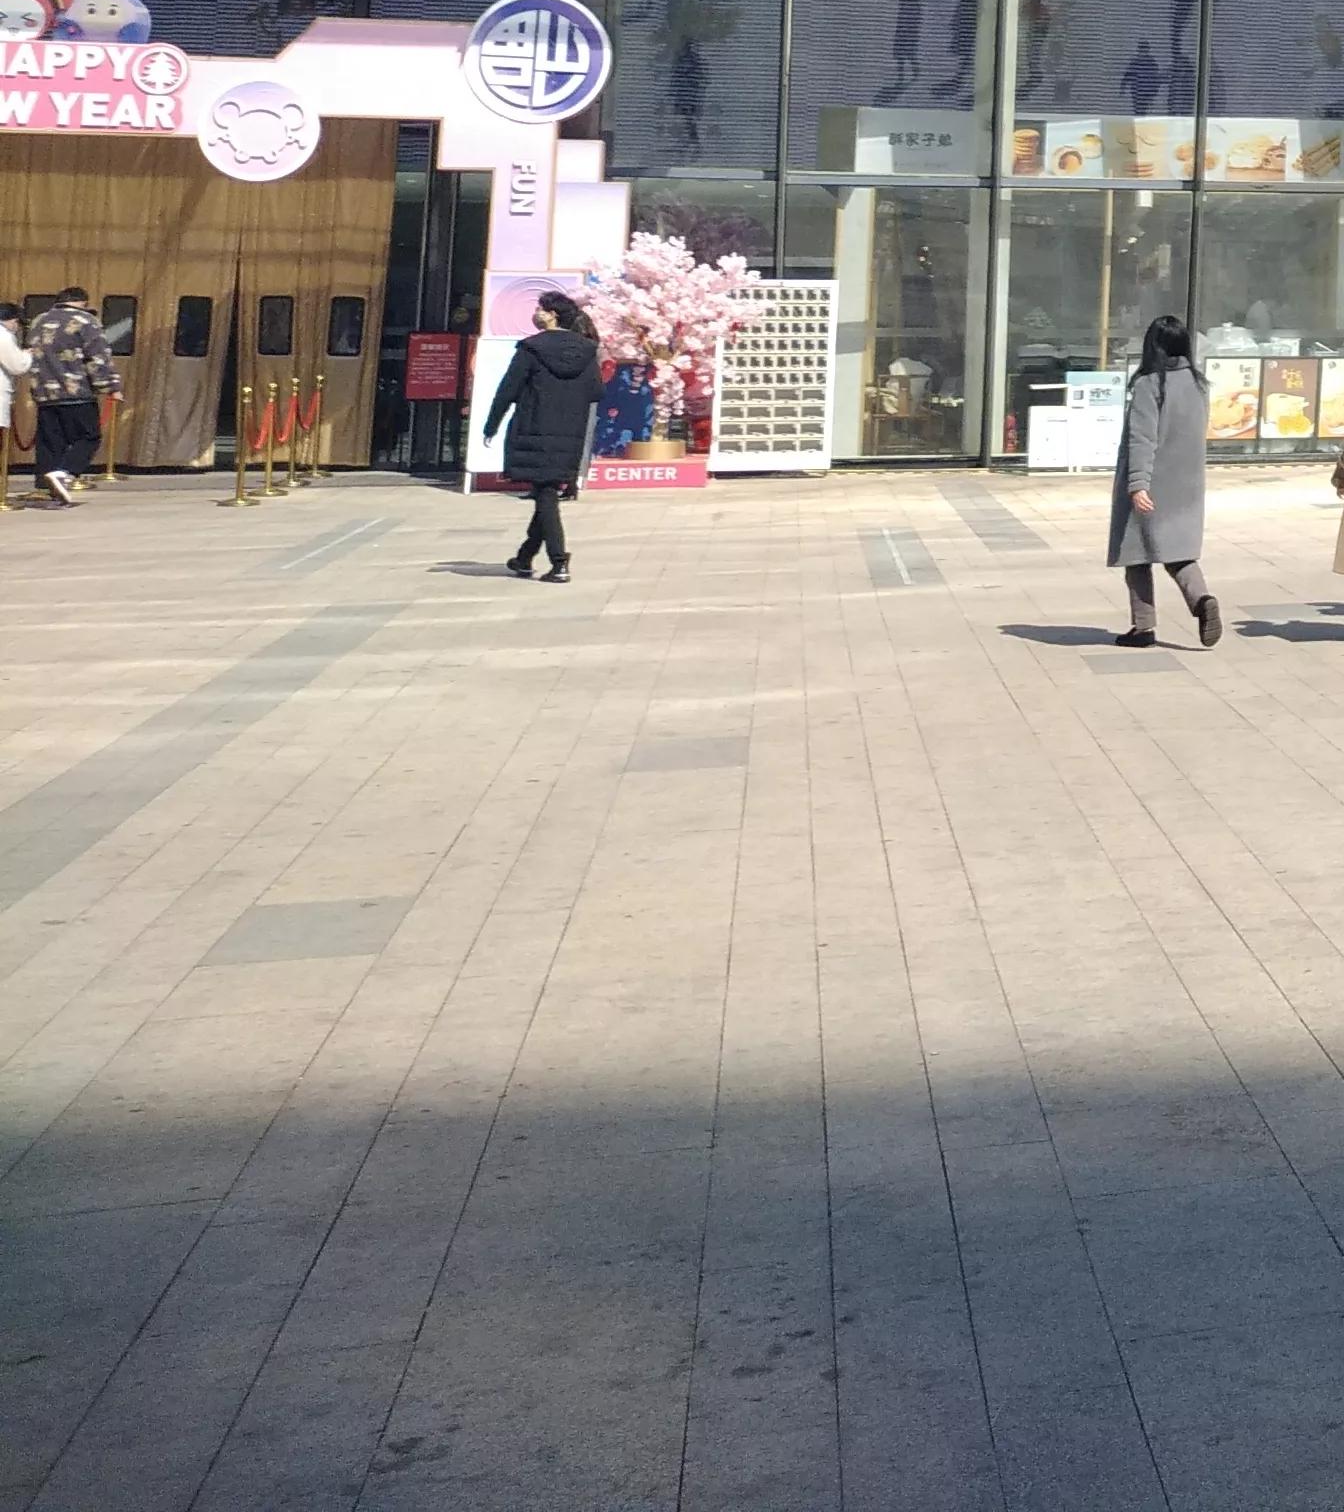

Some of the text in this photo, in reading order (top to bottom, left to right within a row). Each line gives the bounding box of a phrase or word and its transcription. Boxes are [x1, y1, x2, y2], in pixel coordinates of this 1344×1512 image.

[49, 91, 177, 130] YEAR
[510, 159, 537, 217] FUN
[603, 466, 678, 483] CENTER
